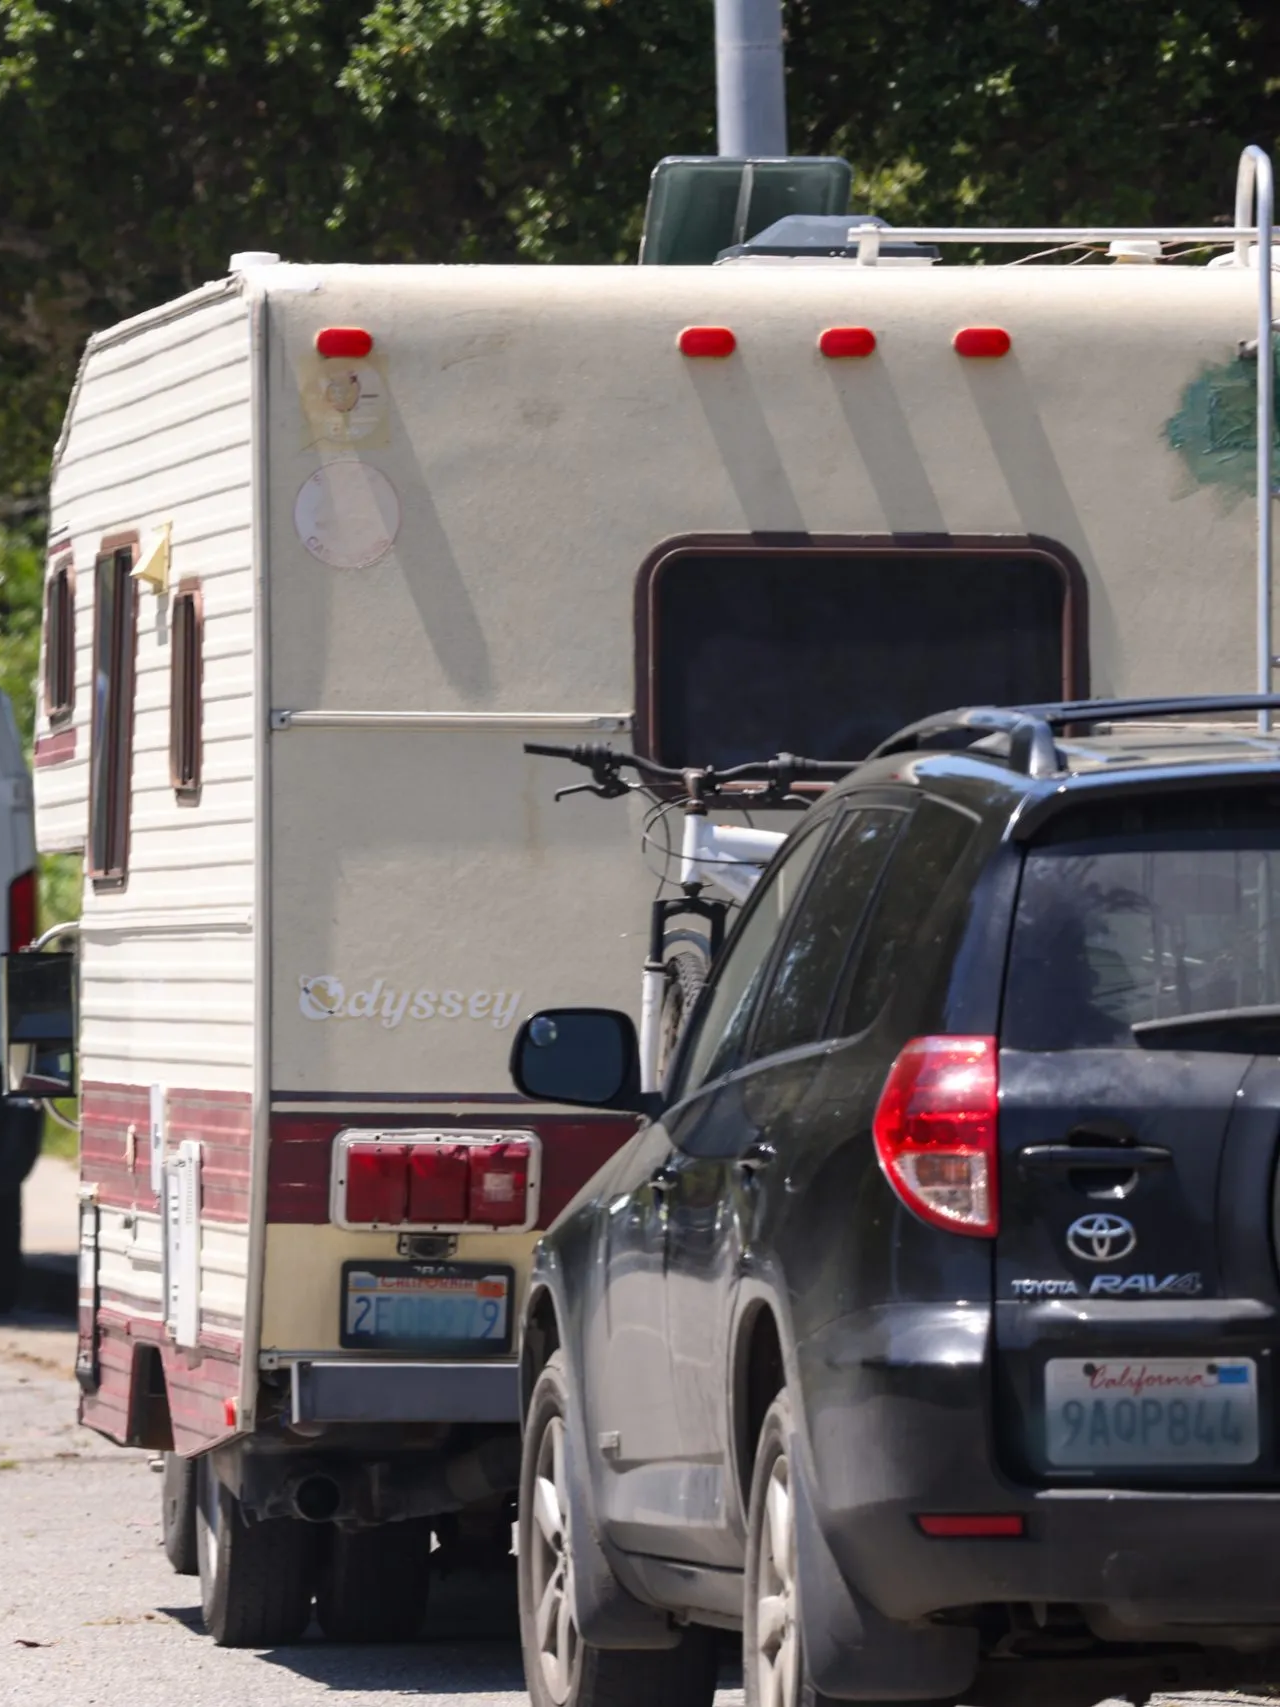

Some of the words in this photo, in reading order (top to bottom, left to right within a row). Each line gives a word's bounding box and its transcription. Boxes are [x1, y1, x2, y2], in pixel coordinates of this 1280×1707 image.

[299, 974, 524, 1030] Odyssey
[1011, 1279, 1078, 1295] TOYOTA
[1089, 1273, 1203, 1295] RAV4
[1088, 1362, 1218, 1395] California
[1061, 1398, 1243, 1447] 9AQP844
